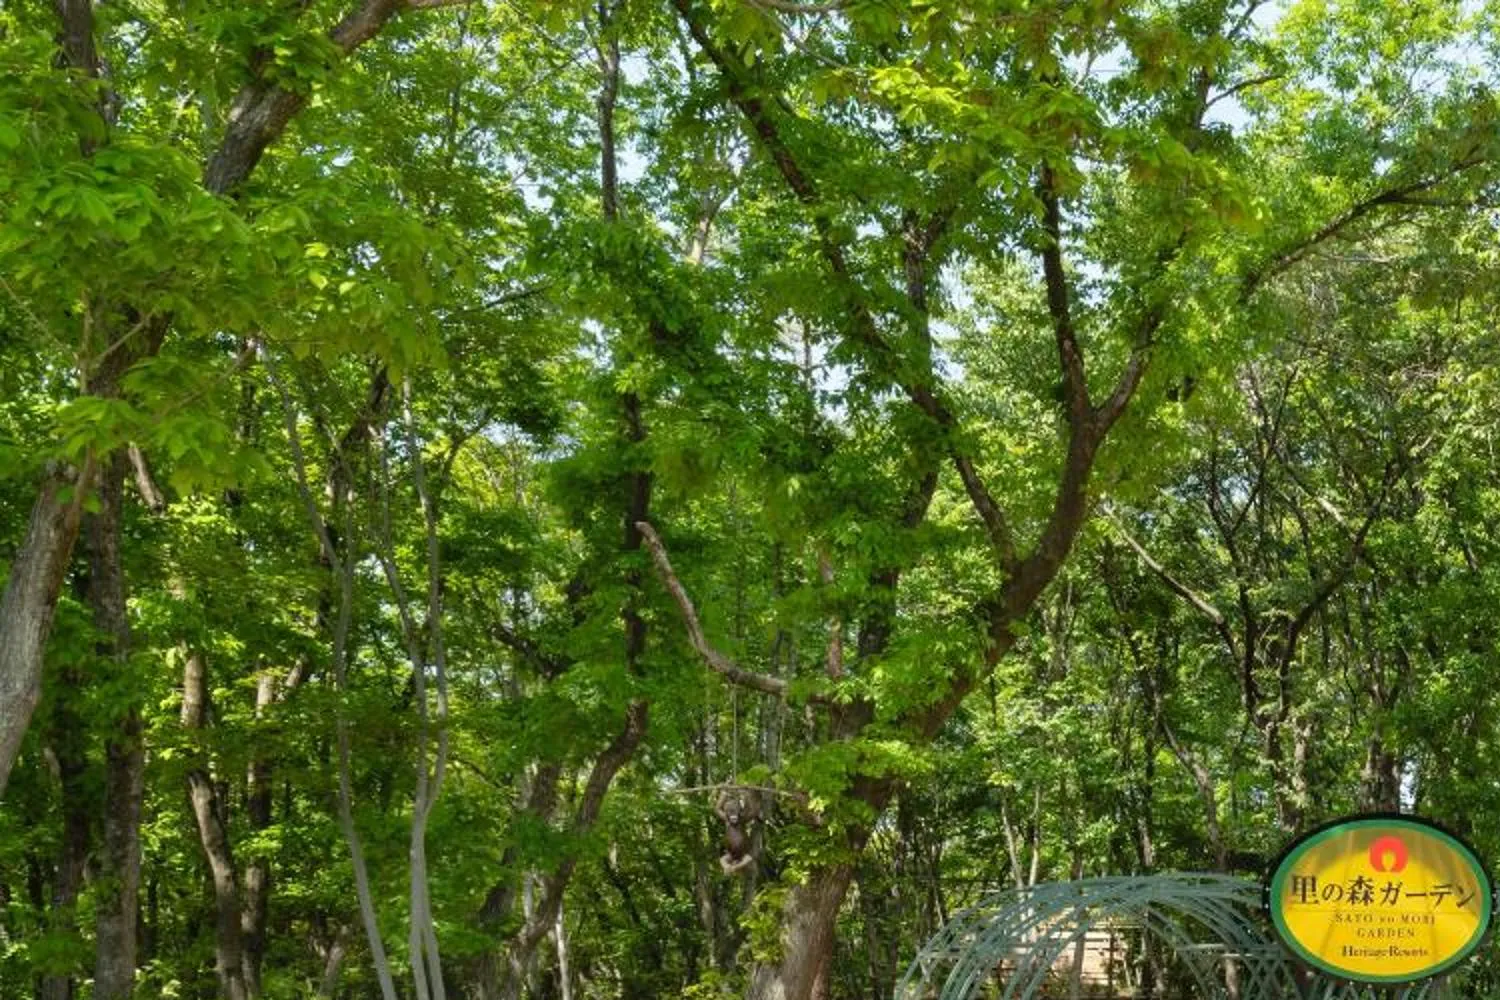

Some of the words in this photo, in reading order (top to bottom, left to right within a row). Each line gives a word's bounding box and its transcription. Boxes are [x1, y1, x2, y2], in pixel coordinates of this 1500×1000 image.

[1292, 874, 1476, 908] 里の森ガーデン
[1335, 913, 1373, 924] SATO
[1401, 913, 1436, 925] MORI
[1356, 928, 1415, 938] GARDEN
